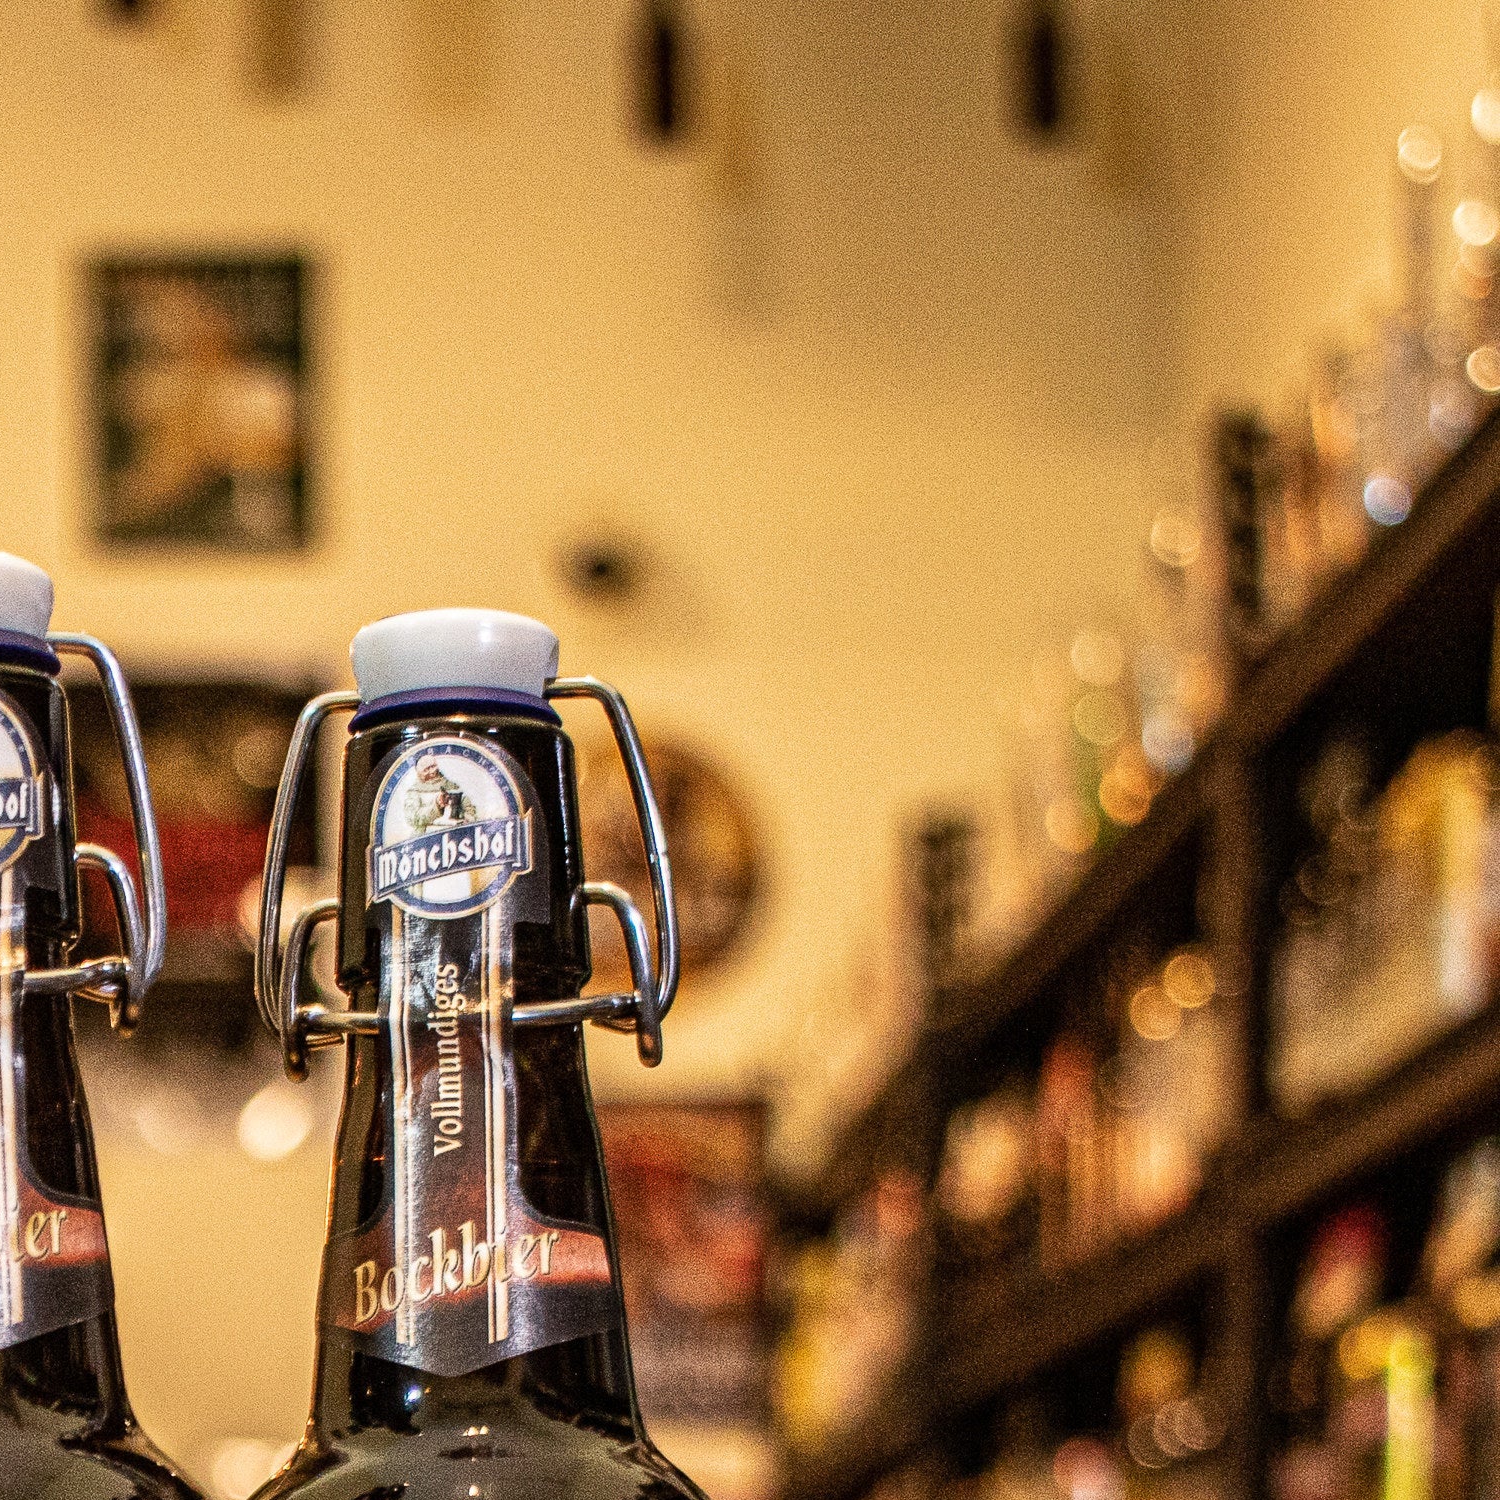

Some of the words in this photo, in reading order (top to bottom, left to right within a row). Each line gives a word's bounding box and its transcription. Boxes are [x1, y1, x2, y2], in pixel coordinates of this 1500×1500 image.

[378, 821, 515, 890] Mönchshof
[427, 963, 466, 1157] Vollmundiges
[353, 1220, 560, 1328] Bockbier
